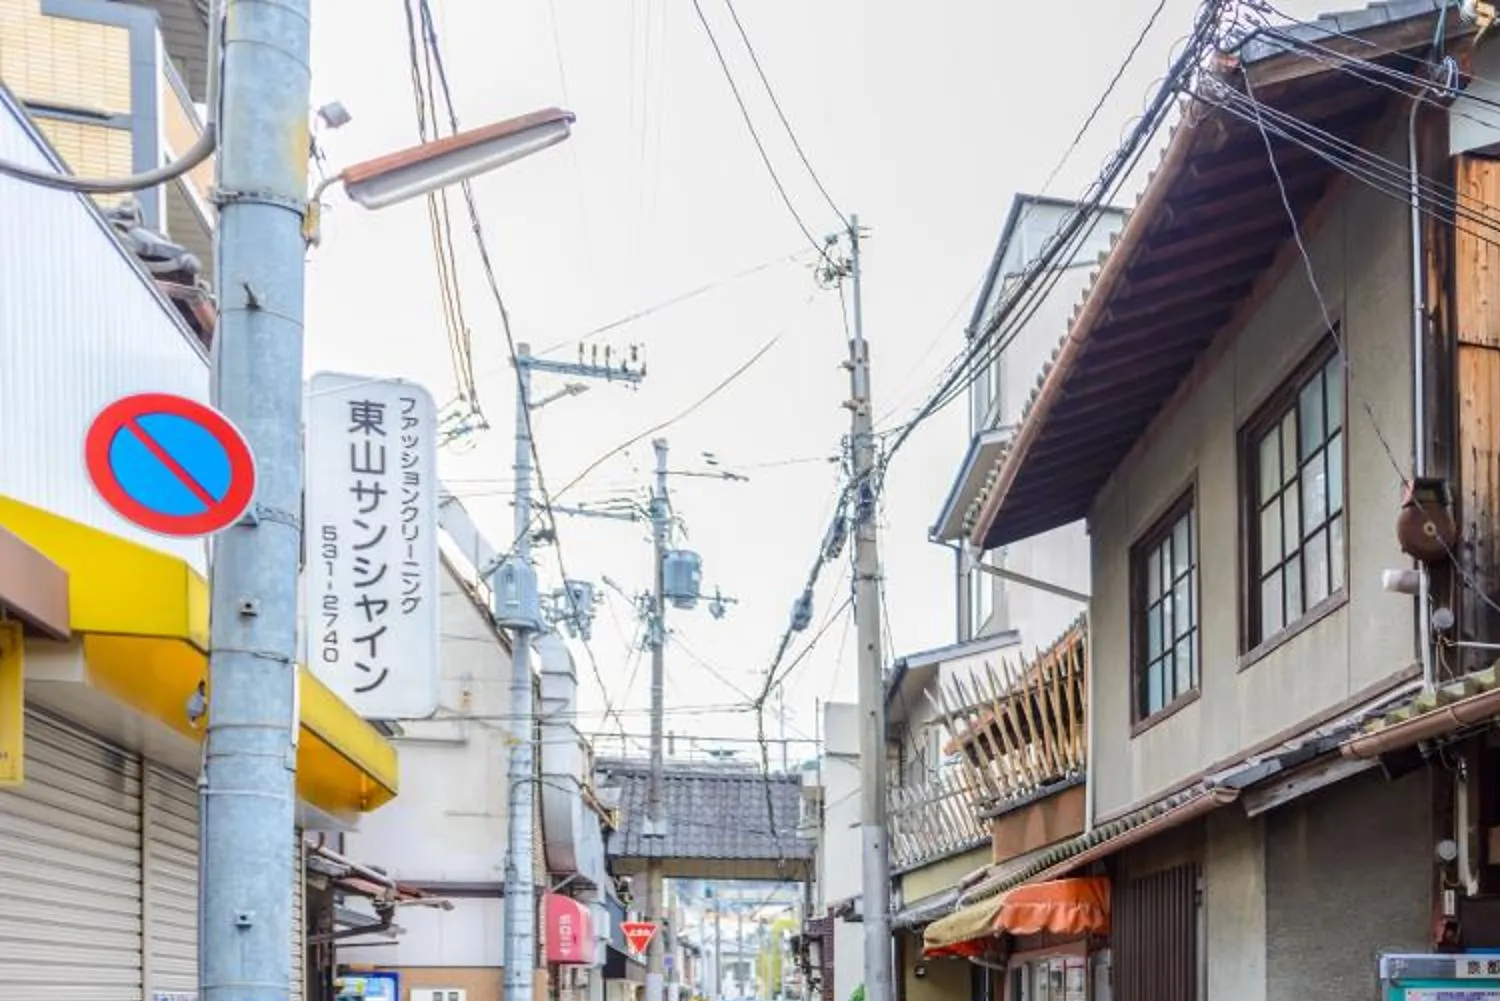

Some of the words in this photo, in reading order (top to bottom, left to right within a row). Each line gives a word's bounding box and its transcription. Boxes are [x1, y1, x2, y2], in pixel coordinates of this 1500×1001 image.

[321, 525, 339, 663] 531-2740
[347, 399, 389, 693] 東山サンシャイン
